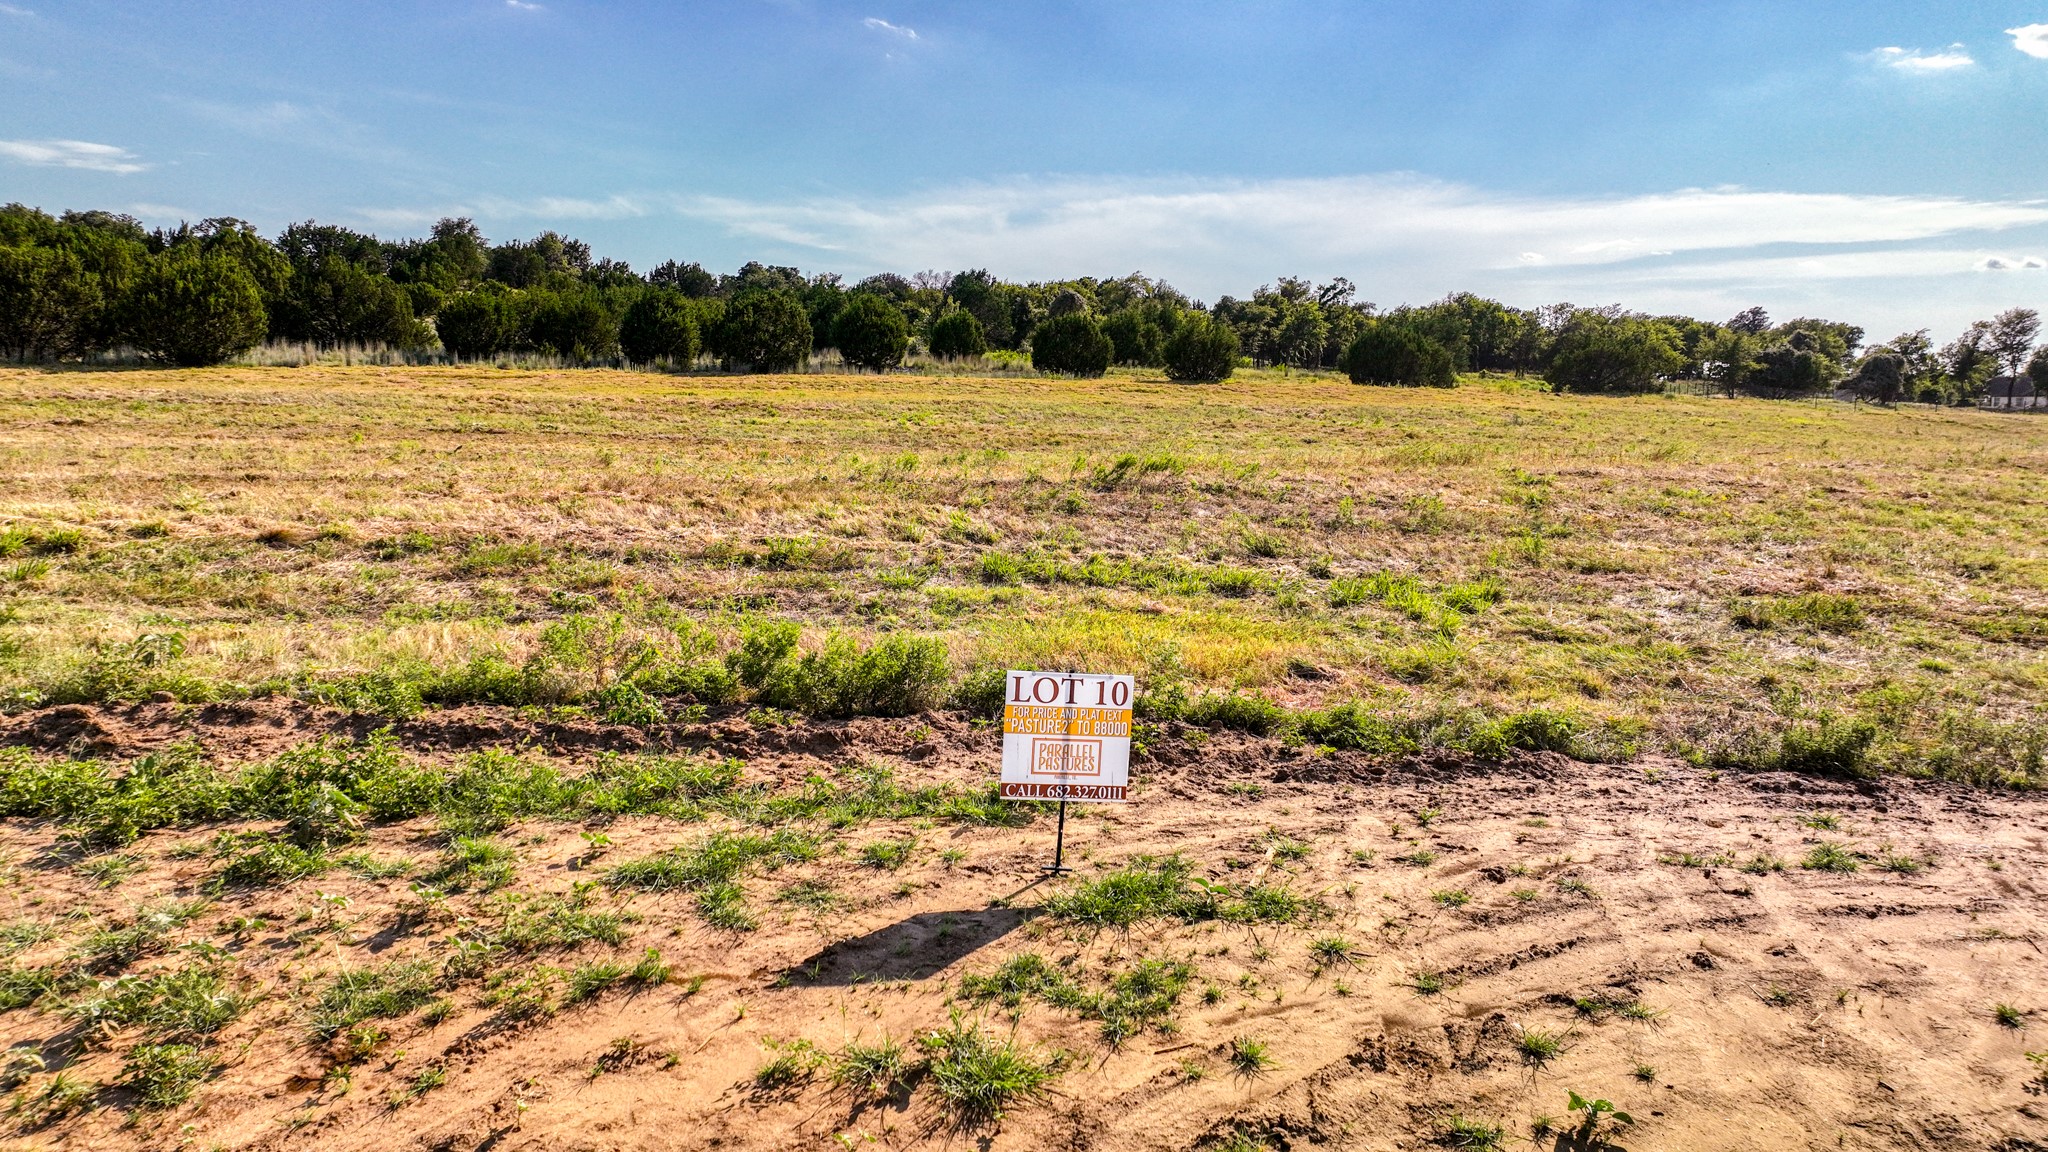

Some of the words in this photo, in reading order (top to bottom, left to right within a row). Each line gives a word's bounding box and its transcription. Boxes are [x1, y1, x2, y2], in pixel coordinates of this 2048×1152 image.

[1011, 676, 1084, 704] LOT
[1095, 681, 1128, 706] 10
[1013, 707, 1030, 717] FOR
[1032, 708, 1057, 718] PRICE
[1060, 709, 1077, 718] AND
[1081, 710, 1100, 720] PLAT
[1100, 710, 1123, 721] TEXT
[1077, 721, 1090, 735] TO
[1094, 722, 1128, 736] 88000
[1040, 743, 1094, 758] PARALLEL
[1038, 756, 1095, 771] PASTURES
[1005, 784, 1044, 797] CALL
[1047, 786, 1122, 799] 682.327.0111
